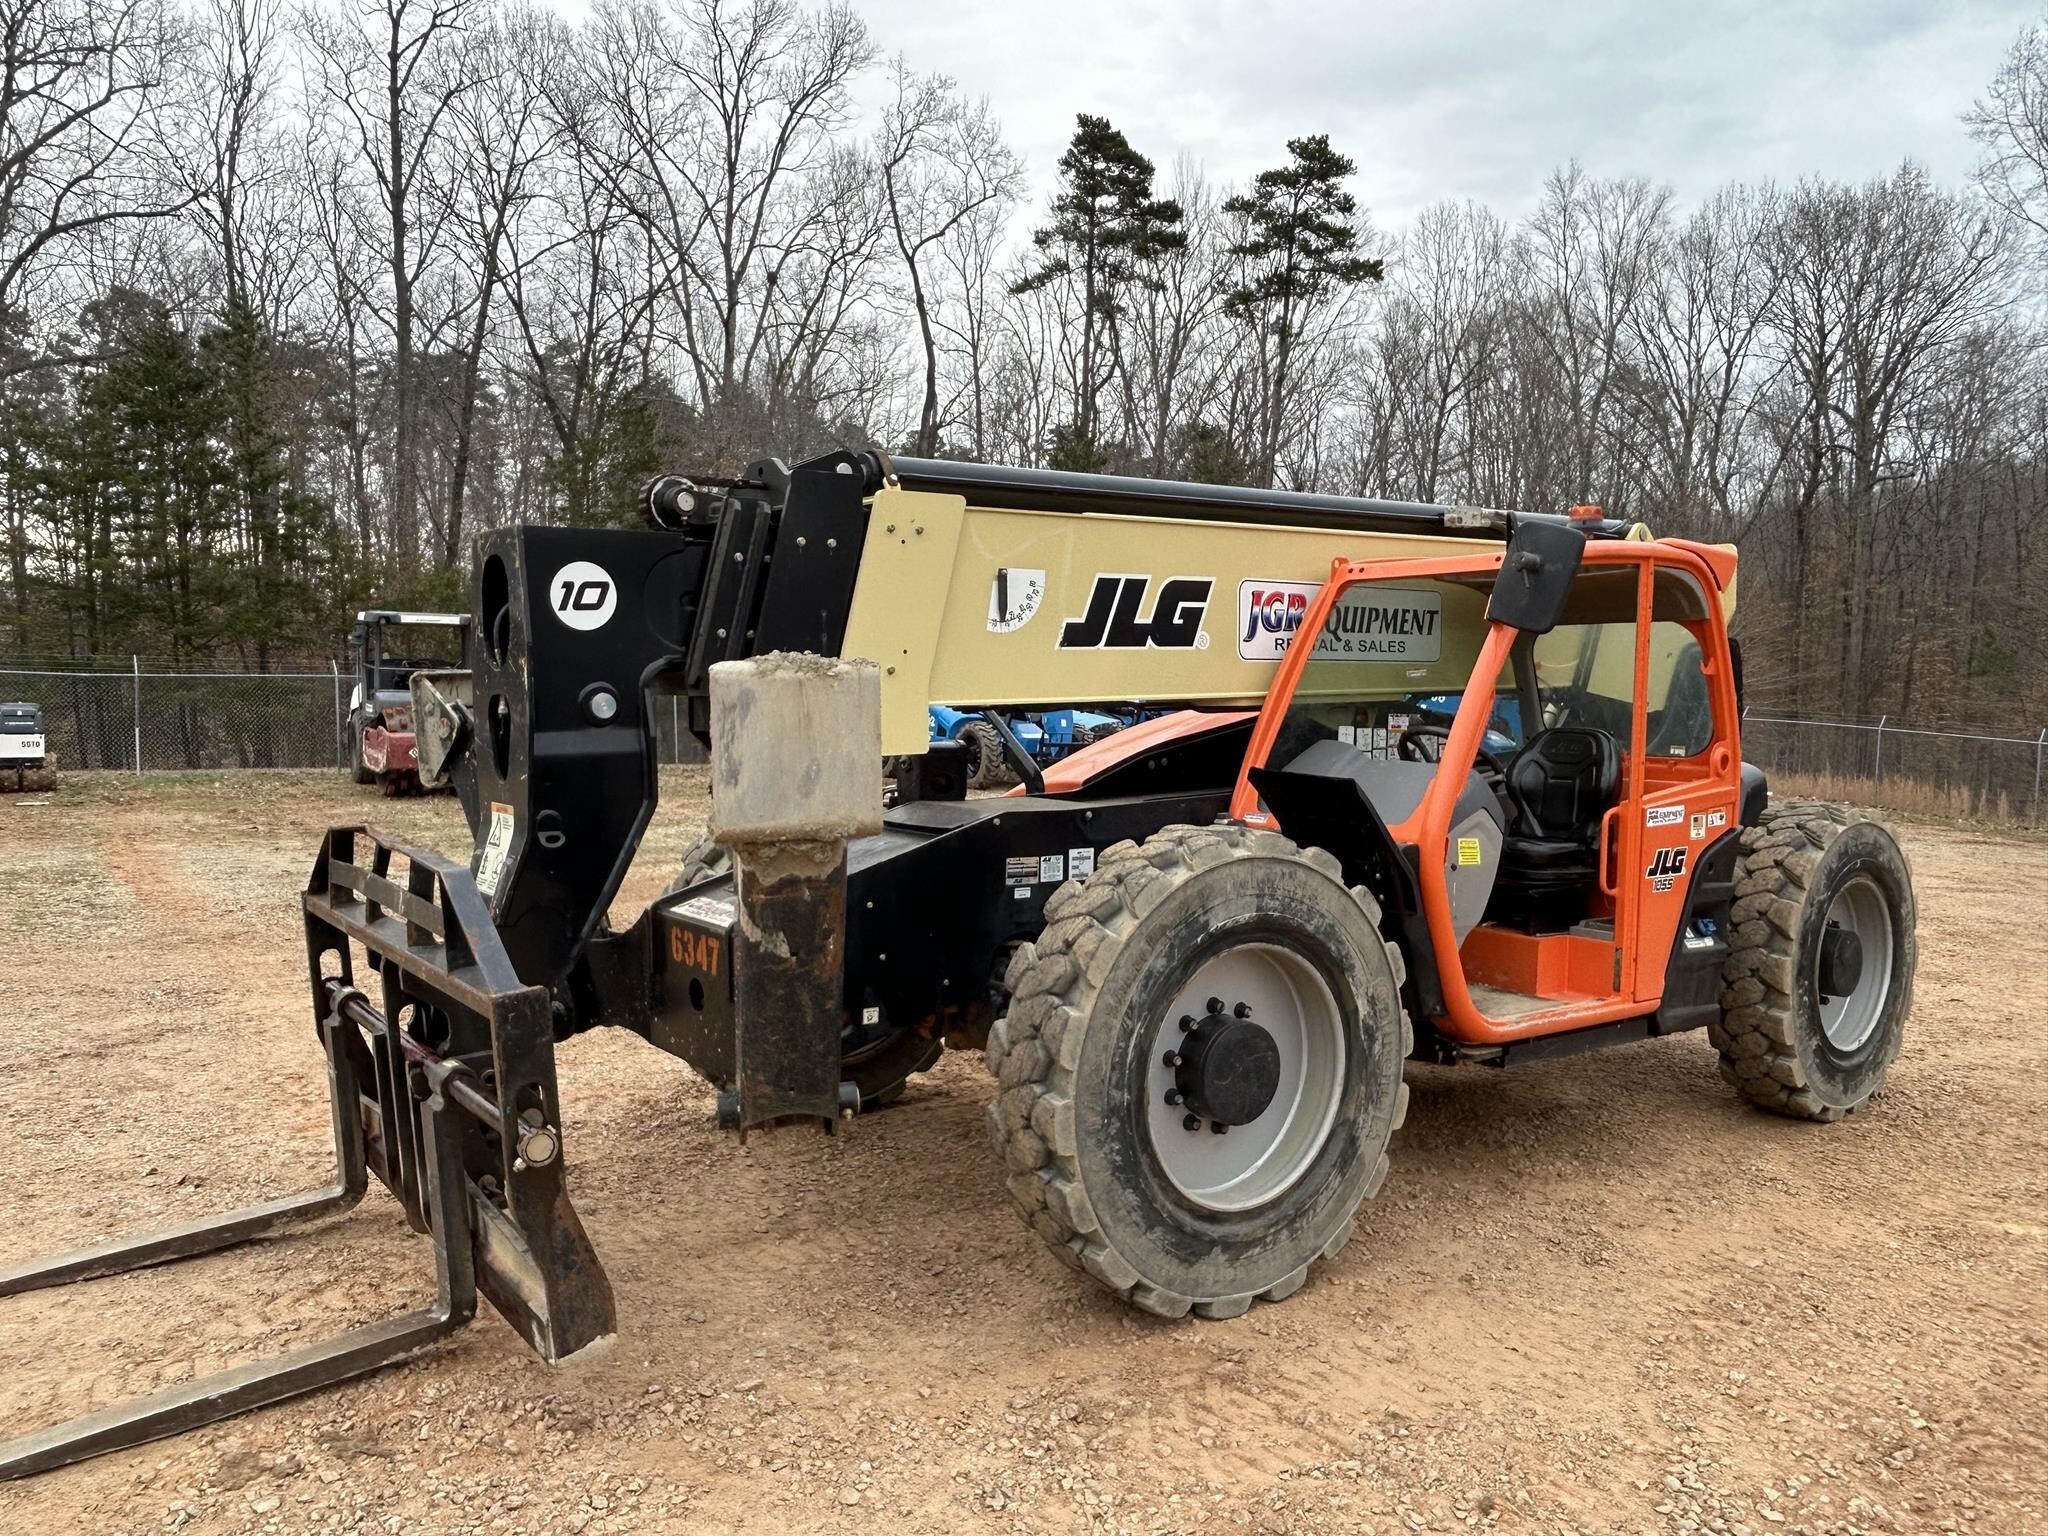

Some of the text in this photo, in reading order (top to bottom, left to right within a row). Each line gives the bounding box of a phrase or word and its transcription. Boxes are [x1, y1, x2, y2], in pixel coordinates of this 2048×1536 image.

[558, 581, 610, 612] 10
[1058, 577, 1213, 648] JLG
[1243, 591, 1440, 643] JGR QUIPMENT
[1343, 638, 1355, 652] &
[1358, 639, 1406, 653] SALES
[1646, 847, 1688, 877] JLG
[671, 926, 720, 976] 6347
